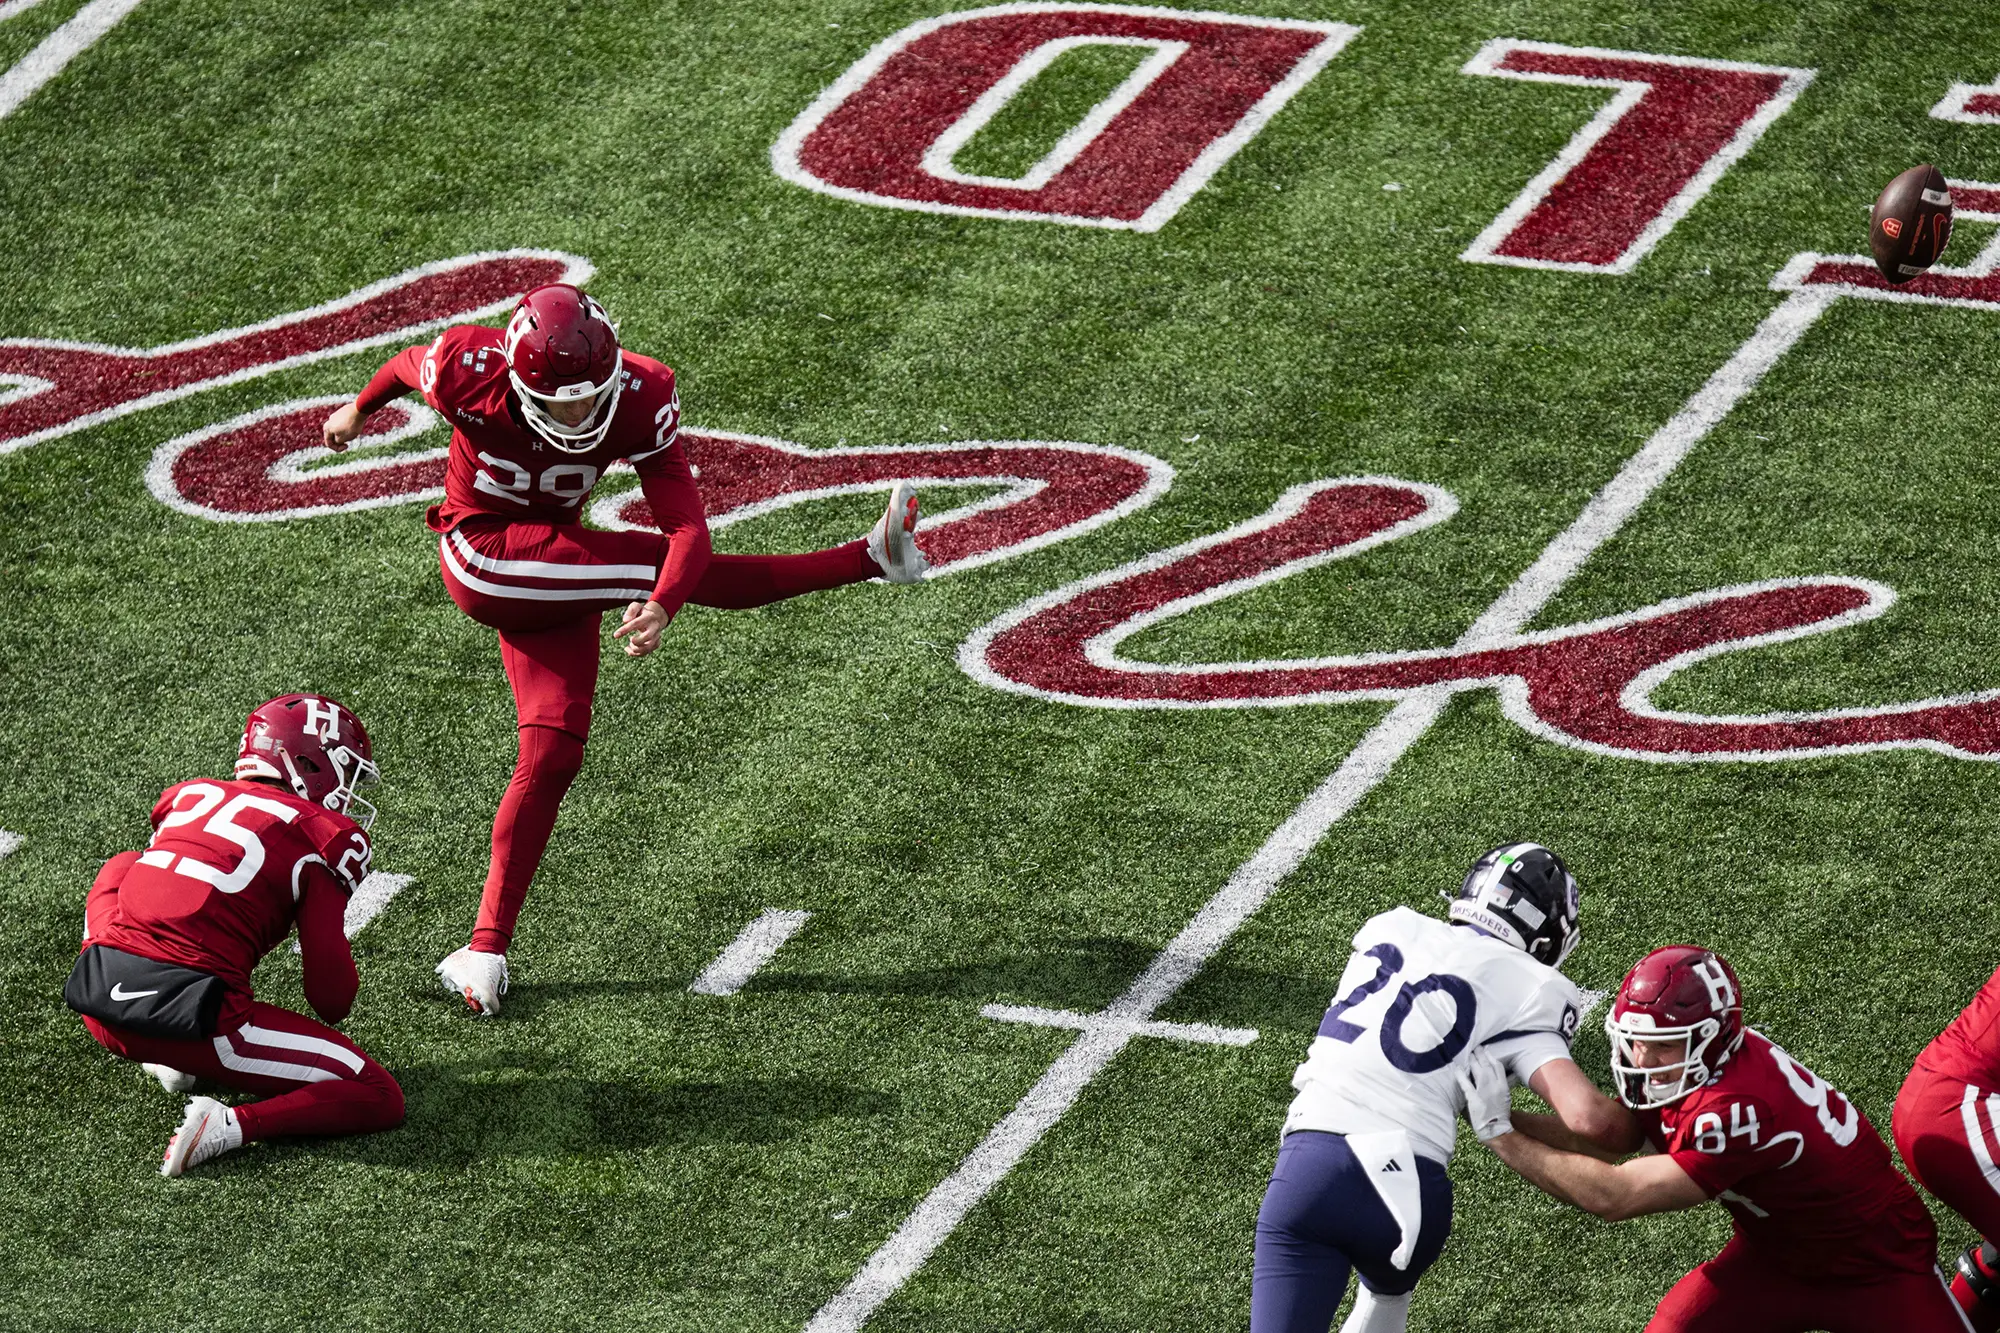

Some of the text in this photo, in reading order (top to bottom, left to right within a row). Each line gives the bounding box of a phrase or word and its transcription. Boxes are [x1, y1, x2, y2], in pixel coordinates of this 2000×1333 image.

[1887, 220, 1900, 234] H
[531, 442, 543, 452] H
[474, 451, 598, 508] 29
[303, 698, 341, 741] H
[136, 782, 300, 894] 25
[1451, 905, 1511, 938] CRUSADERS
[1317, 942, 1477, 1074] 20
[1692, 956, 1737, 1011] H
[1693, 1101, 1761, 1155] 84
